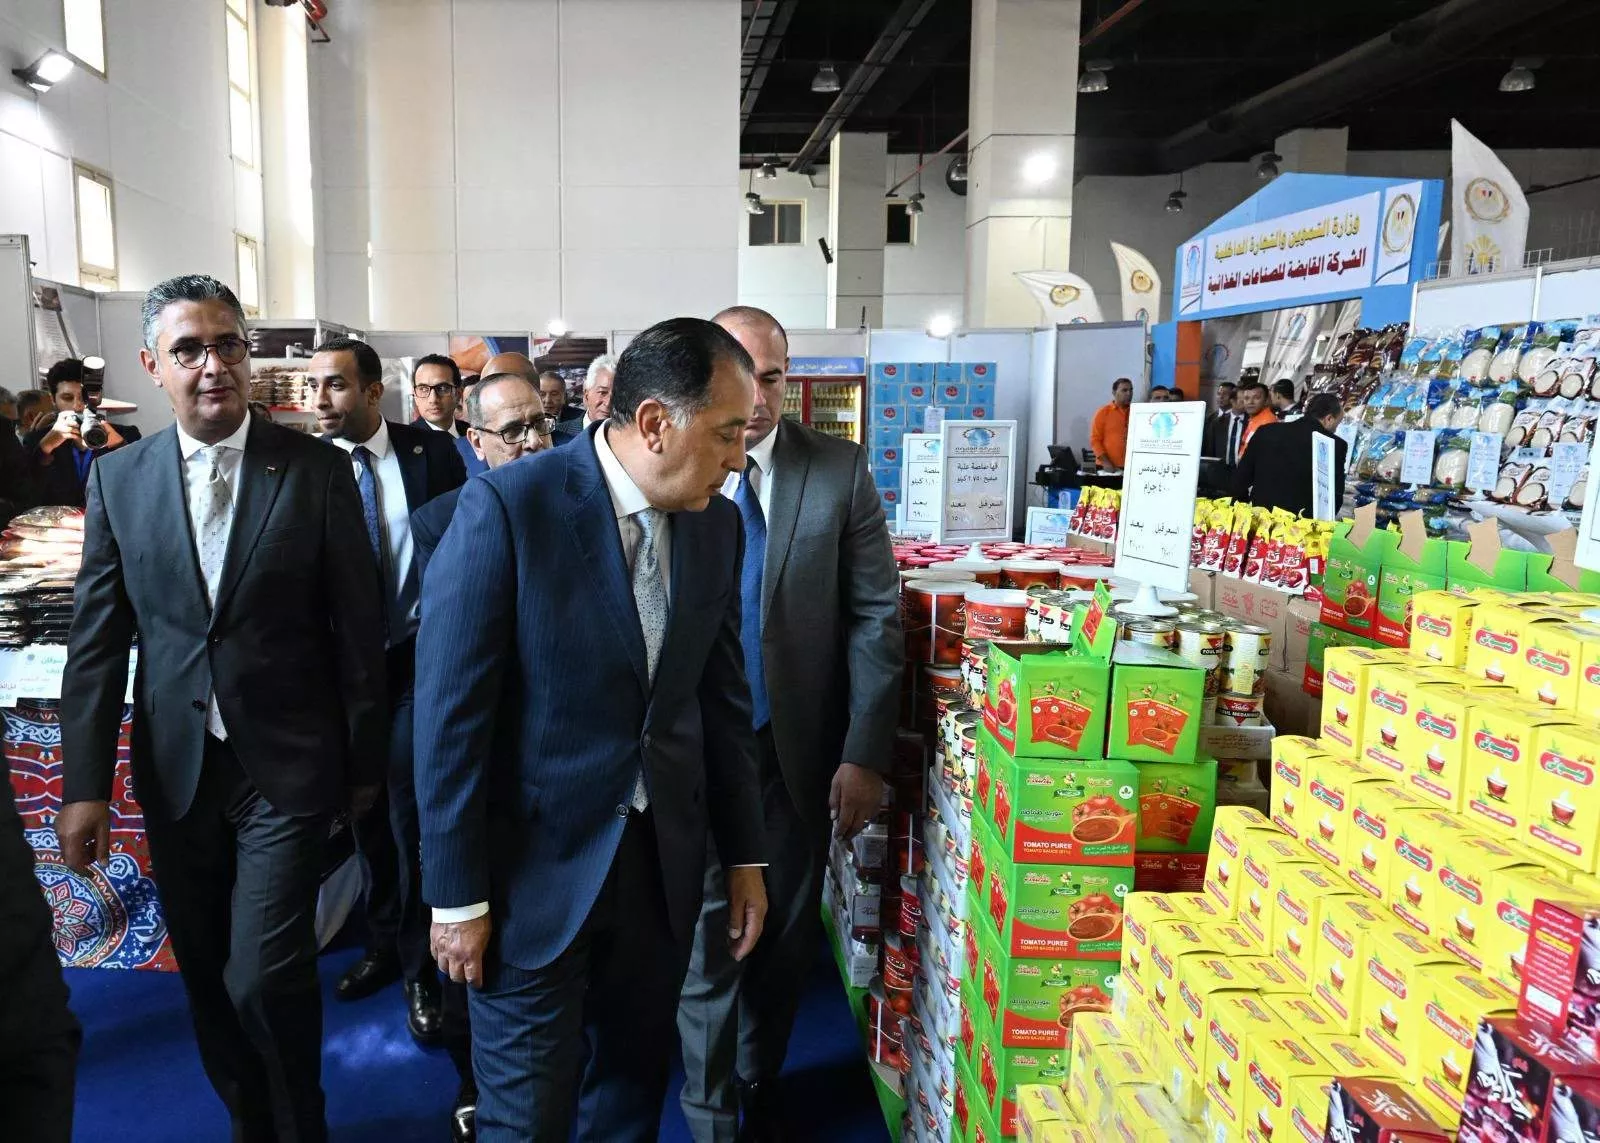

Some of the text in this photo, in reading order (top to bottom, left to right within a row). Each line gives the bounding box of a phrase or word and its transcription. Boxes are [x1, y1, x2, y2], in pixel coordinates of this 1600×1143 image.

[1215, 214, 1360, 262] وزارة التموين والتجارة الداخلية
[1208, 247, 1367, 295] الشركة القابضة للصناعات الغذائية
[1157, 463, 1171, 478] فول
